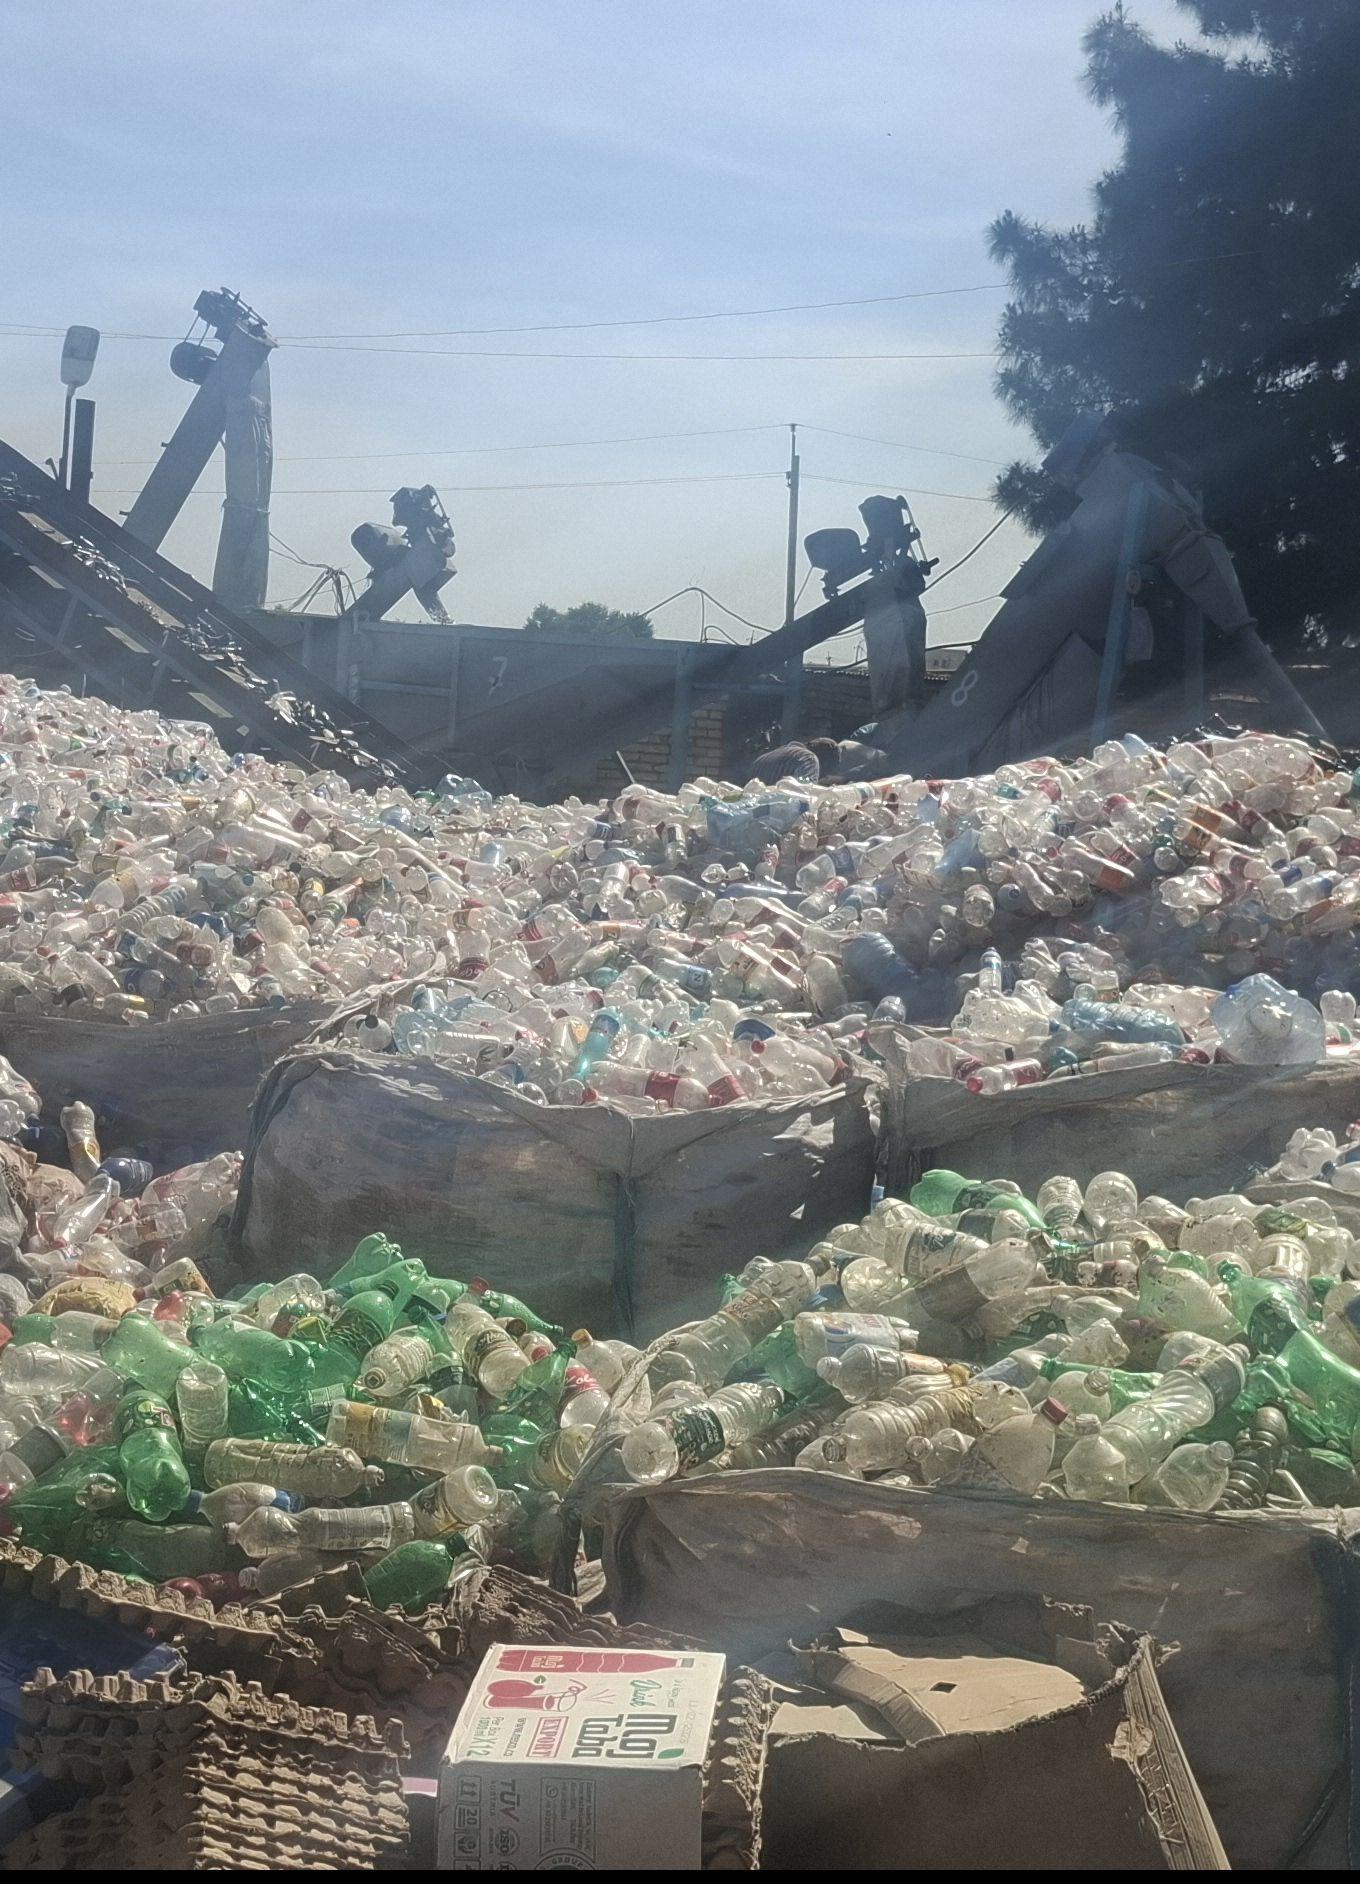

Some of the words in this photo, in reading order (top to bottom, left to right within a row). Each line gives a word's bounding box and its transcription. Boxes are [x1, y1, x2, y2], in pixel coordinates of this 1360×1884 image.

[951, 669, 978, 707] 8
[629, 1679, 662, 1708] Drink
[532, 1717, 560, 1758] EXPORT
[571, 1713, 625, 1758] Taba
[605, 1713, 678, 1758] Moj
[466, 1808, 478, 1826] 20
[499, 1828, 510, 1853] ISO
